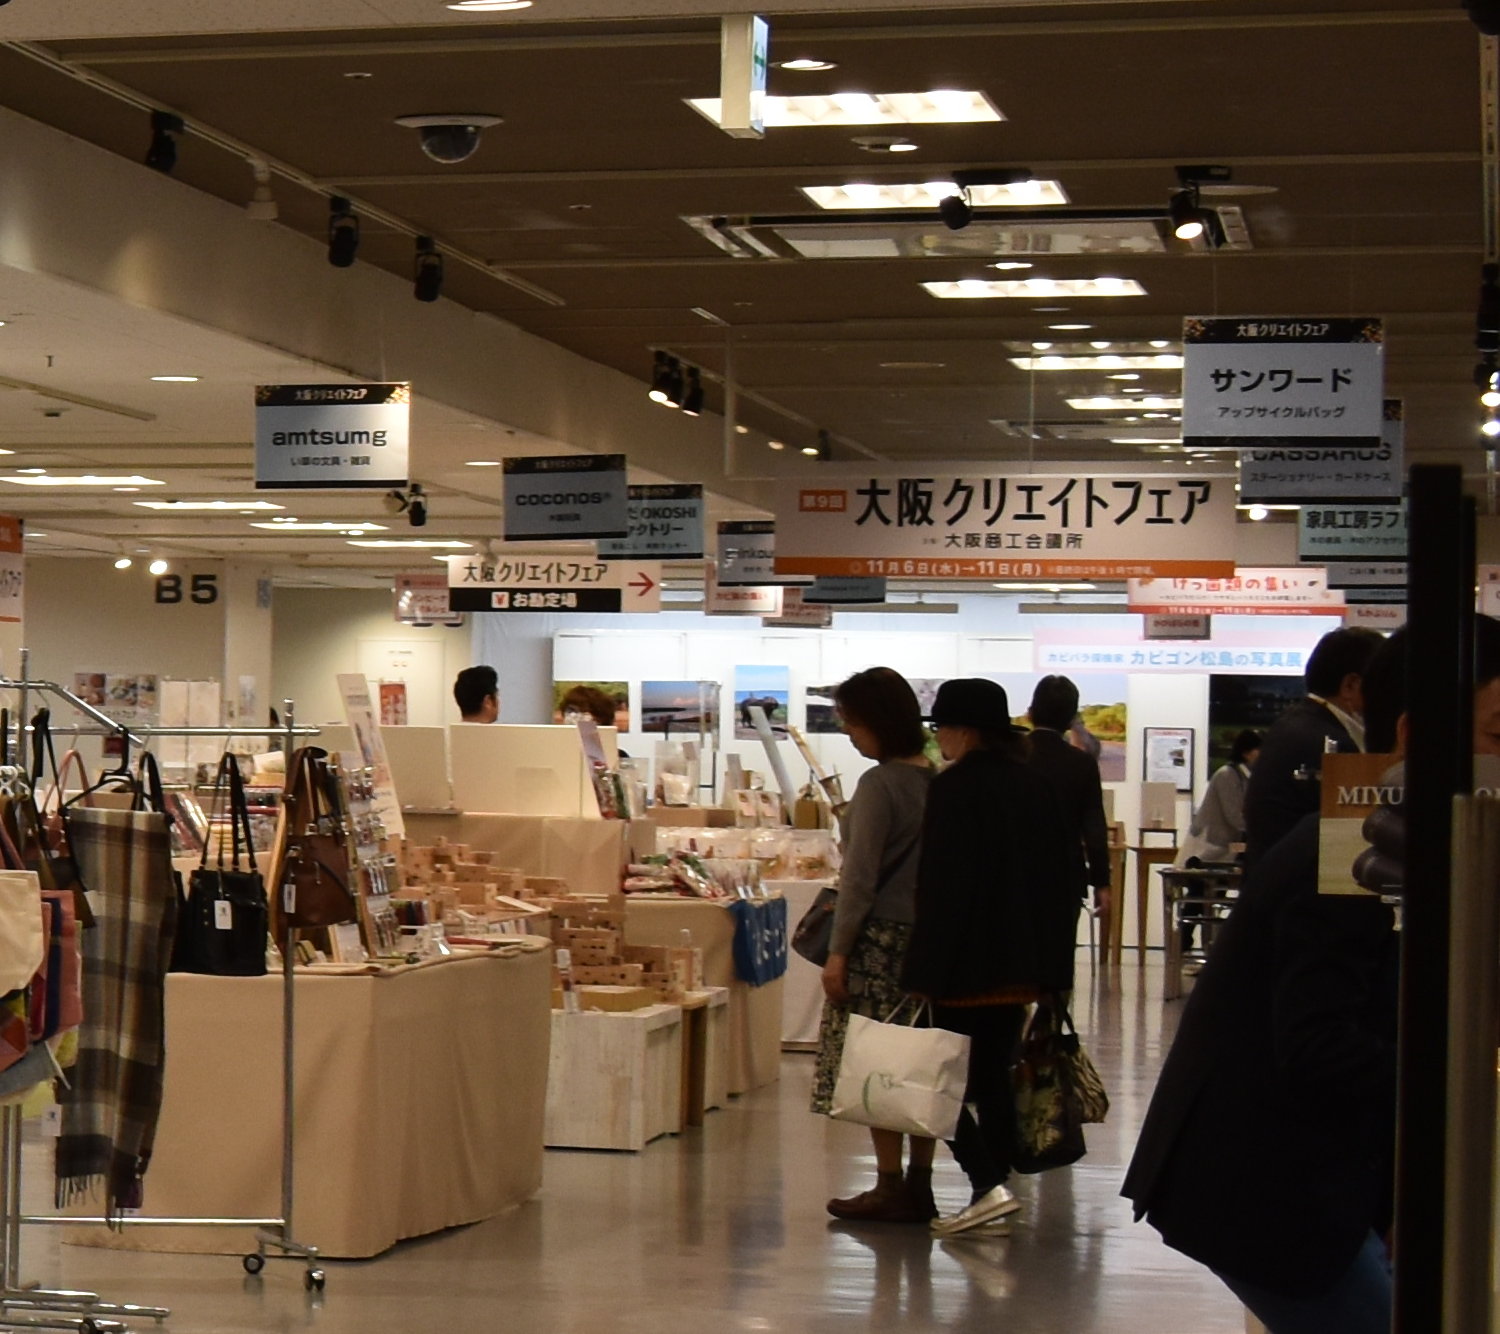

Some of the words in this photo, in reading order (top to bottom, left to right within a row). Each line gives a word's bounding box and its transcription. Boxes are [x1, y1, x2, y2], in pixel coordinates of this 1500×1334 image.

[1236, 323, 1330, 338] 大阪クリエイトフェア
[1210, 368, 1352, 393] サンワード
[272, 428, 387, 447] amtsumg
[855, 478, 1211, 528] 大阪クリエイトフェア
[945, 533, 1084, 550] 大阪商工会議所
[463, 562, 608, 583] 大阪クリエイトフェア
[155, 573, 219, 605] B5
